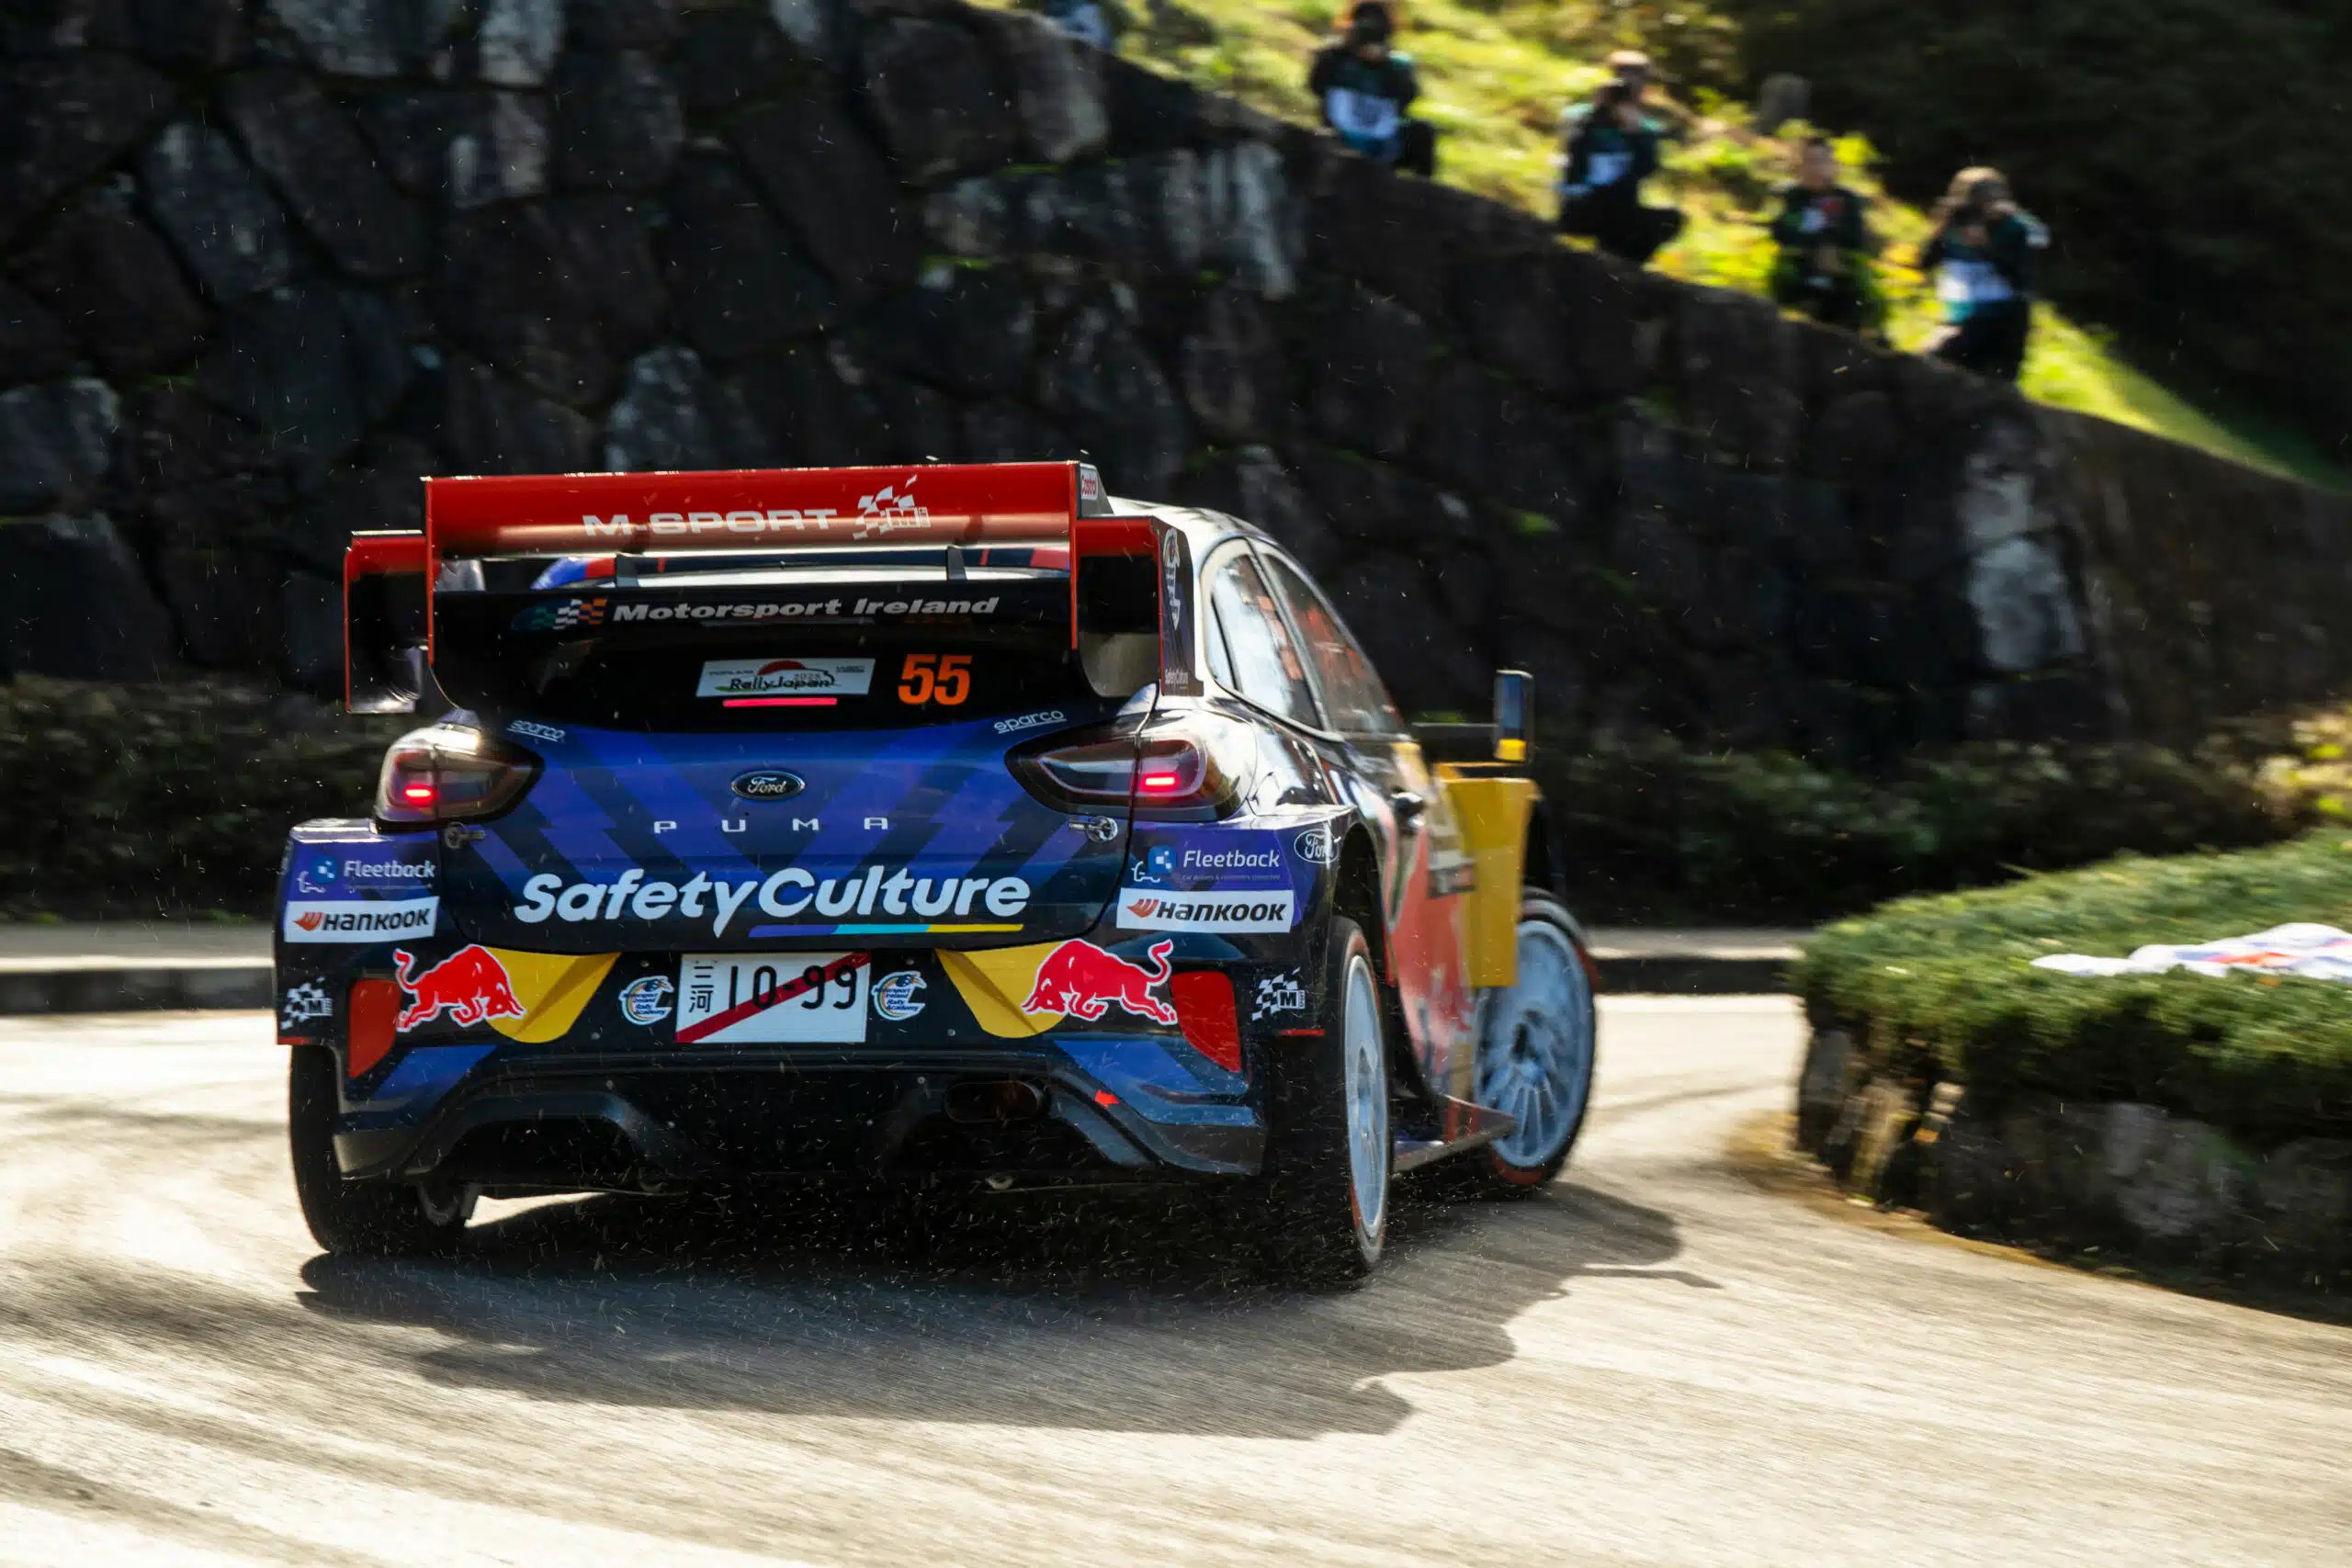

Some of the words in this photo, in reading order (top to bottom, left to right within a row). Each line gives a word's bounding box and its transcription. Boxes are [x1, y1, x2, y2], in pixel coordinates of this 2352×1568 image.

[582, 509, 837, 536] M-SPORT
[613, 599, 842, 621] Motorsport
[853, 596, 1000, 615] Ireland
[898, 654, 972, 705] 55
[510, 720, 565, 739] sparco
[993, 710, 1064, 732] sparco
[747, 775, 787, 795] Ford
[344, 859, 436, 878] Fleetback
[1183, 849, 1280, 868] Fleetback
[514, 864, 1031, 938] SafetyCulture
[689, 965, 714, 1012] 三河
[729, 964, 857, 1010] 10-99
